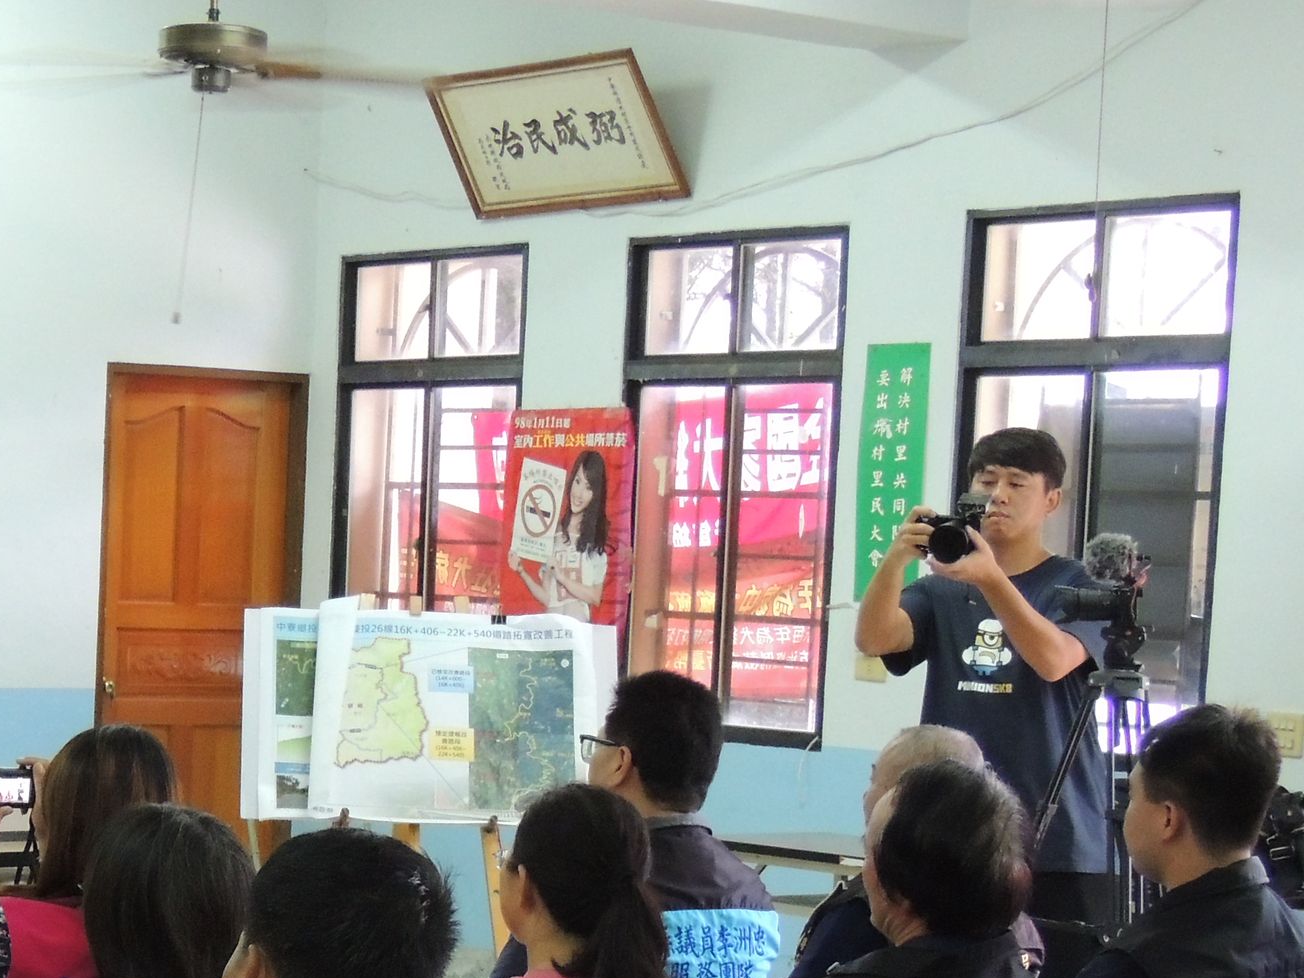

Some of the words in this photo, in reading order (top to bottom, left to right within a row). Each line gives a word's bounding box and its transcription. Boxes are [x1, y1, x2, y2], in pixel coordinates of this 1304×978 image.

[665, 924, 766, 958] 議員李洲忠
